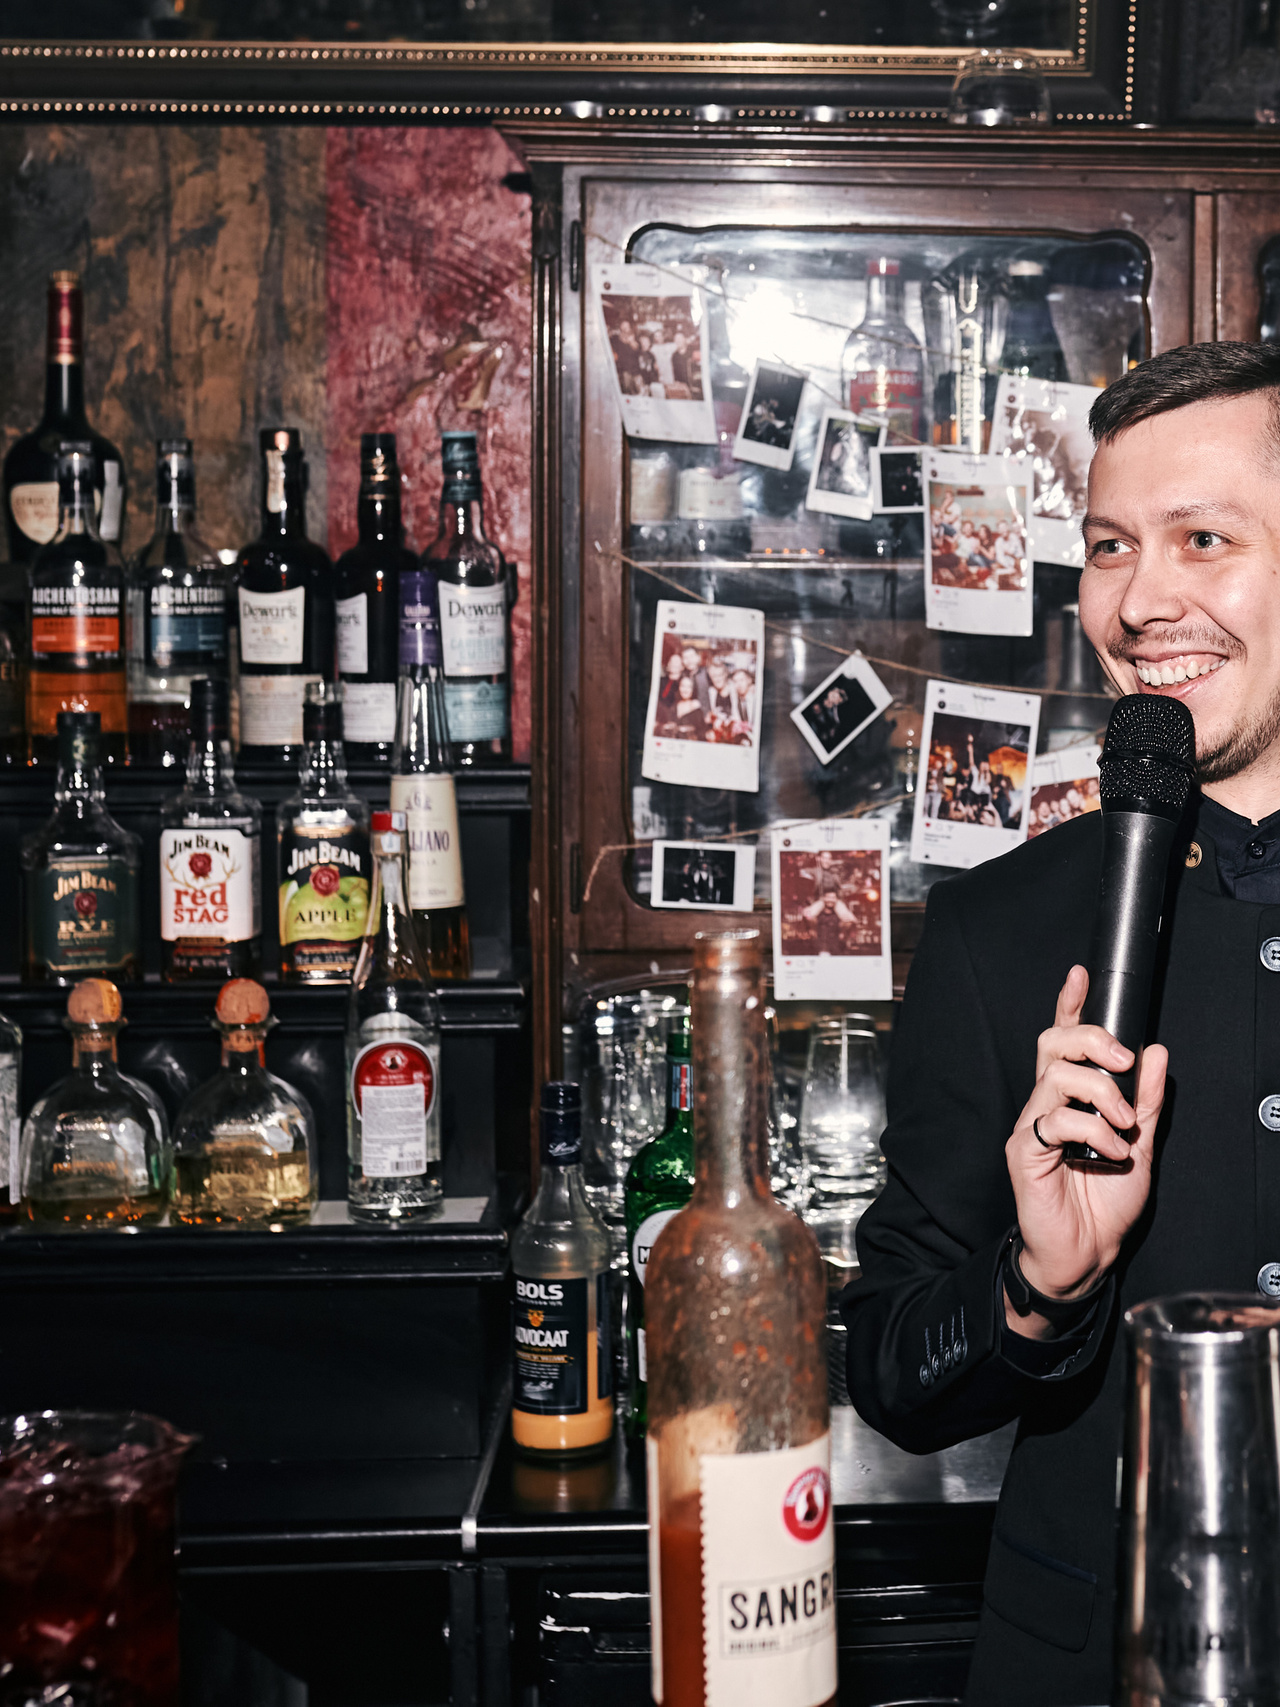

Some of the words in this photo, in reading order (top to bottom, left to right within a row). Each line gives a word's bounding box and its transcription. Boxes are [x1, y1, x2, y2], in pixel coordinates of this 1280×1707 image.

[169, 840, 193, 859] JIM
[195, 835, 231, 858] BEAM
[287, 848, 318, 875] JIM
[318, 840, 361, 872] BEAM
[53, 875, 80, 901] JIM
[81, 870, 117, 895] BEAM
[174, 882, 227, 906] red
[173, 908, 229, 923] STAG
[294, 909, 358, 923] APPLE
[516, 1280, 564, 1300] BOLS
